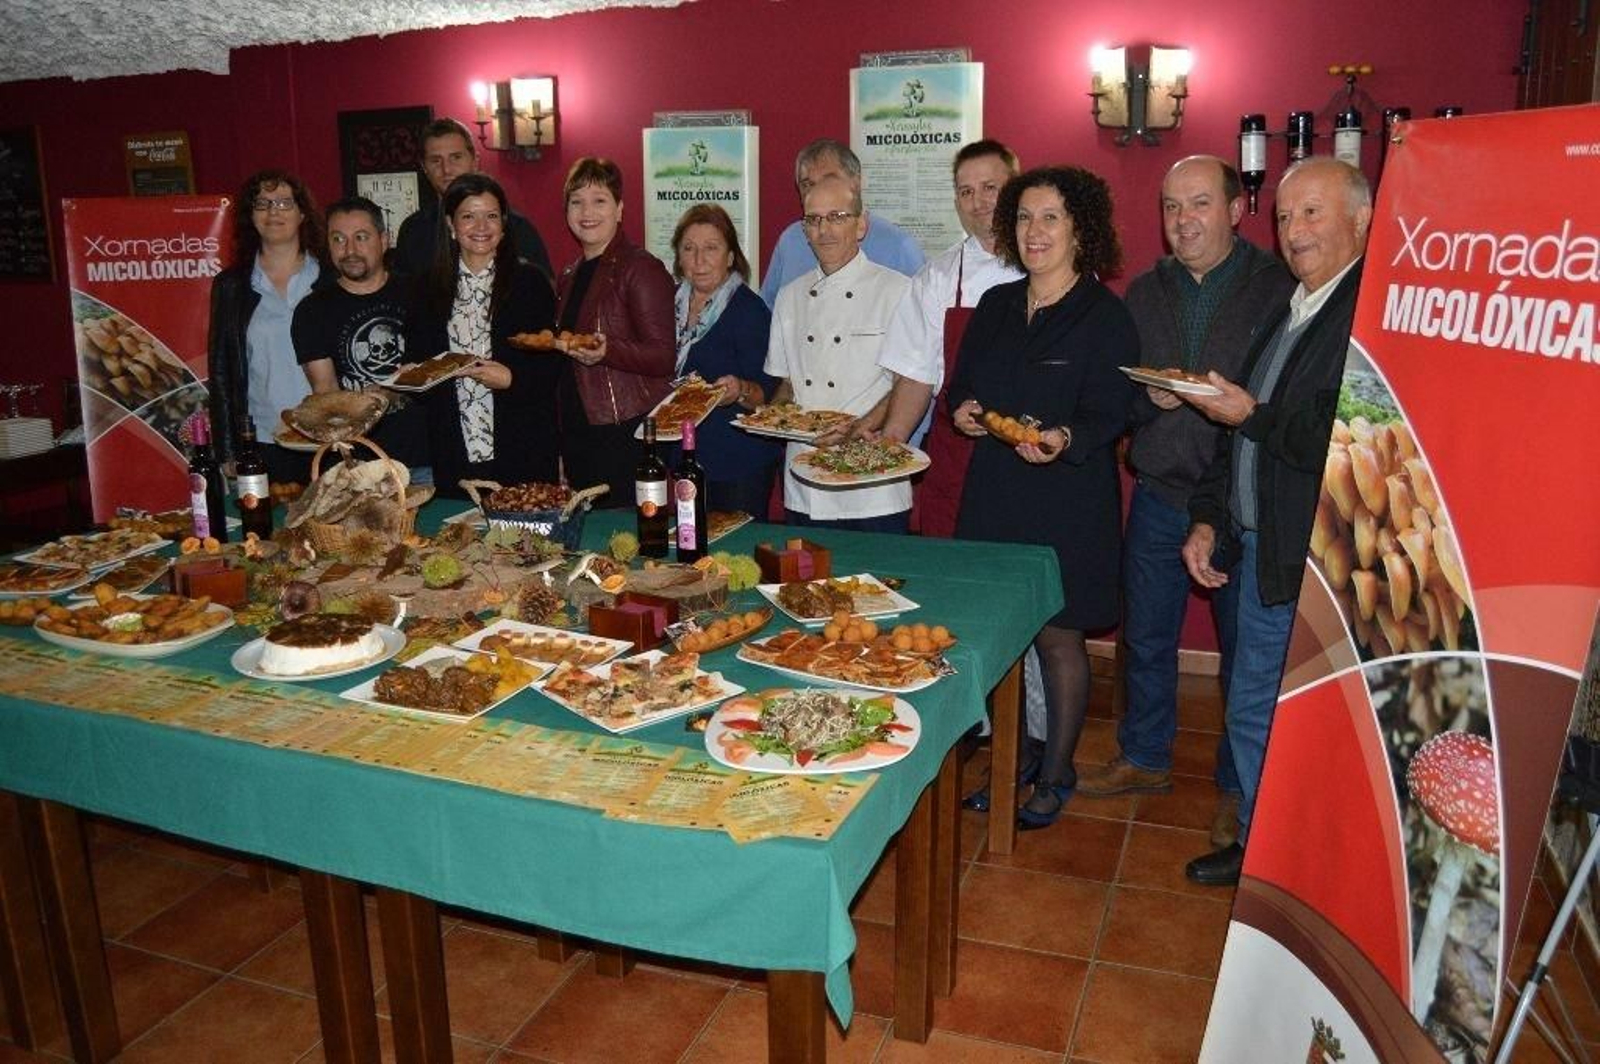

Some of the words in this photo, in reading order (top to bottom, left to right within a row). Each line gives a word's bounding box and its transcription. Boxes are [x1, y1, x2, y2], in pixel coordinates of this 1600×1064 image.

[866, 131, 962, 145] MICOLÓXICAS
[657, 189, 740, 201] MICOLÓXICAS
[84, 232, 219, 257] Xornadas
[1391, 216, 1600, 283] Xornada
[87, 255, 222, 282] MICOLÓXICAS
